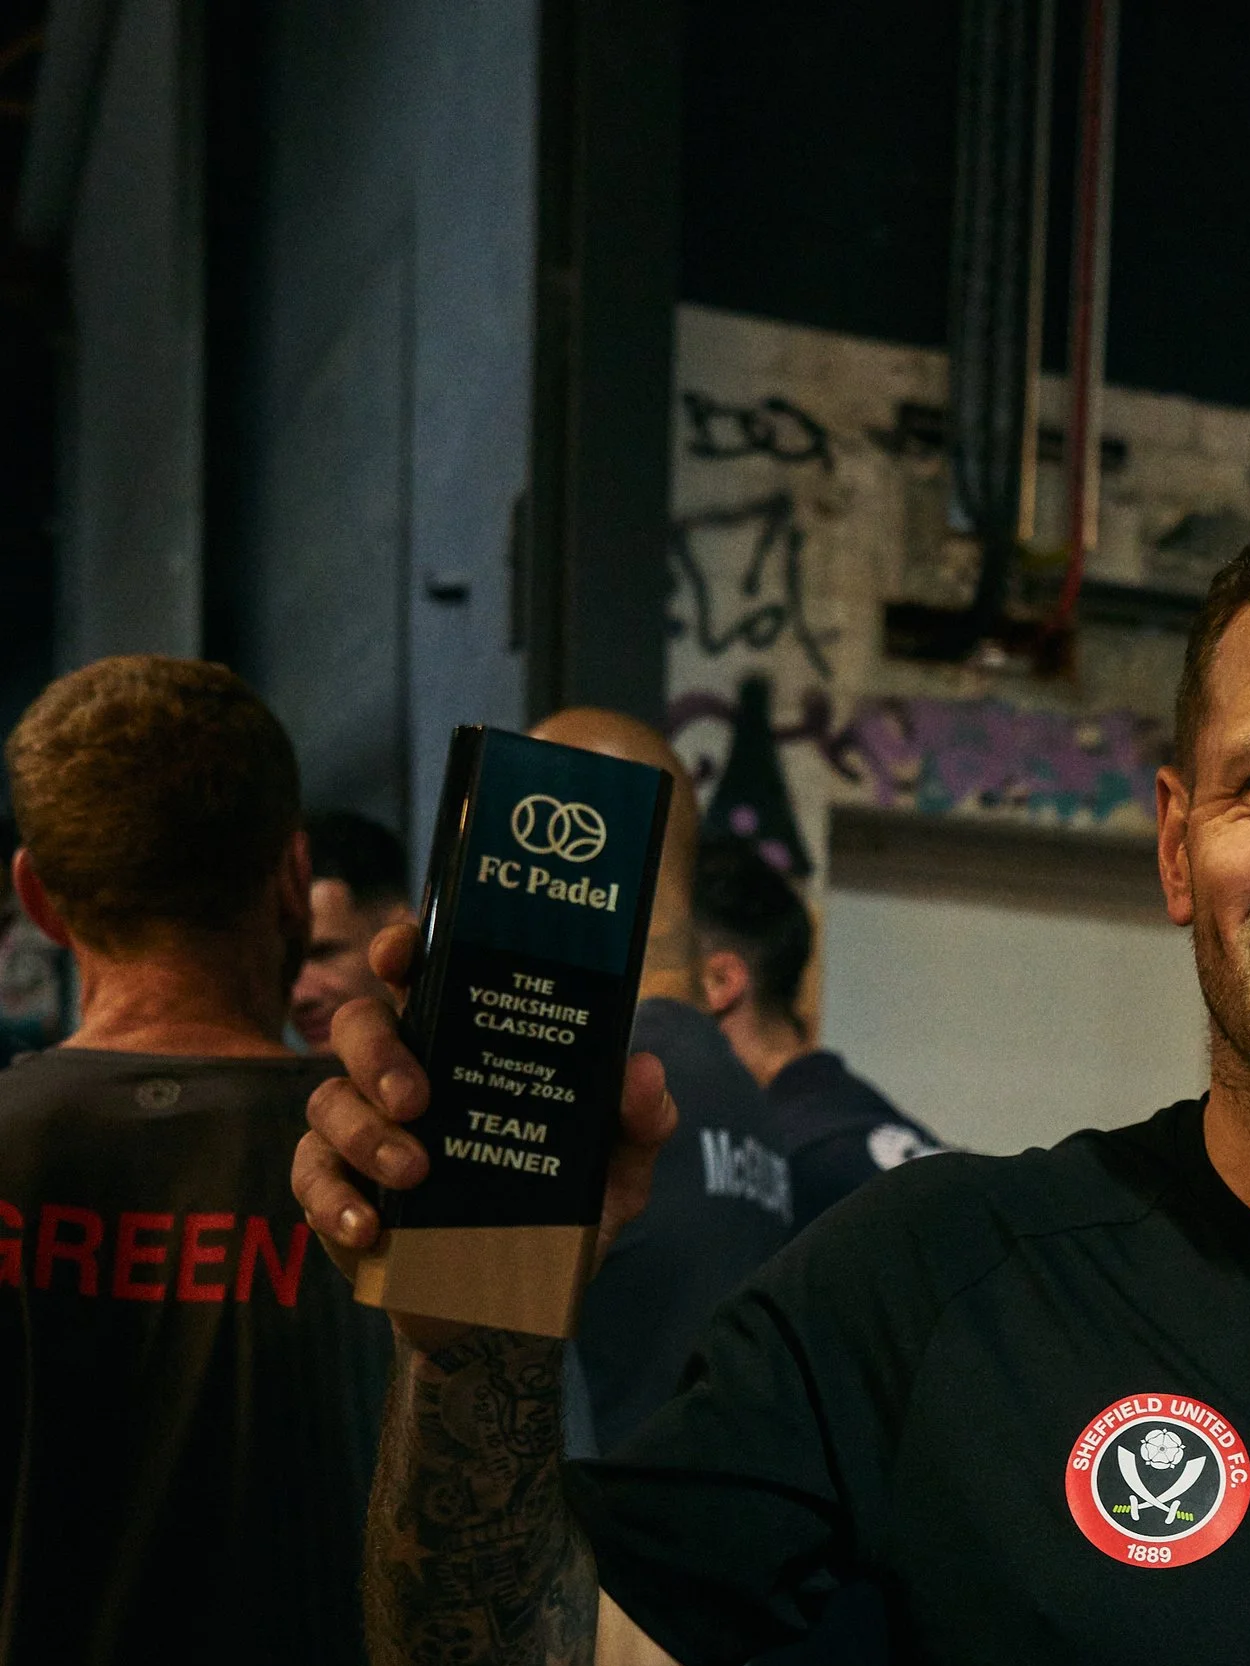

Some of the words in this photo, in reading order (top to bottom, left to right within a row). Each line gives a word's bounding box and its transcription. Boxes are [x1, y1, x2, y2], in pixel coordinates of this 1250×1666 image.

[477, 854, 521, 889] FC
[526, 865, 620, 913] Padel
[512, 972, 556, 995] THE
[468, 985, 591, 1026] YORKSHIRE
[473, 1011, 576, 1045] CLASSICO
[452, 1065, 485, 1085] 5th
[488, 1073, 527, 1097] May
[530, 1080, 576, 1103] 2026
[481, 1050, 557, 1082] Tuesday
[467, 1109, 548, 1143] TEAM
[443, 1136, 561, 1177] WINNER
[1072, 1397, 1163, 1471] SHEFFIELD
[1169, 1398, 1236, 1449] UNITED
[1227, 1451, 1249, 1489] F.C.
[1126, 1543, 1172, 1564] 1889
